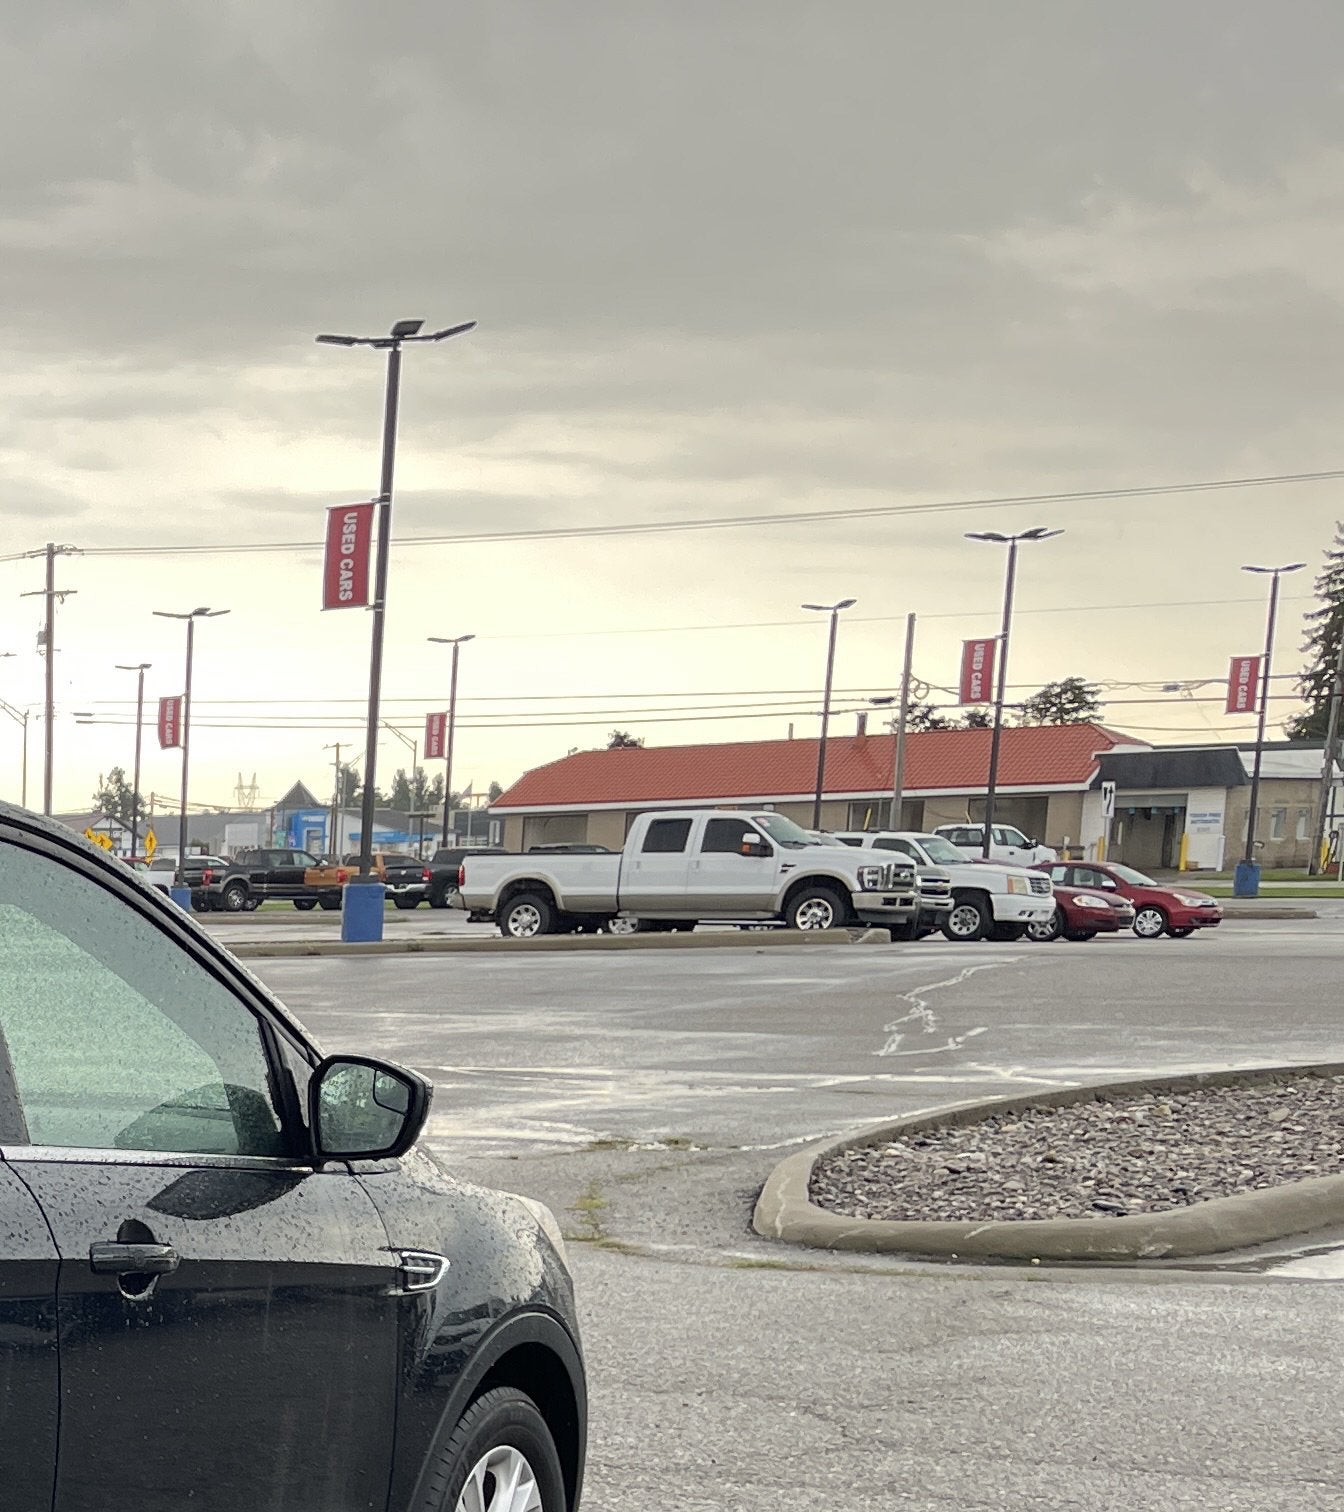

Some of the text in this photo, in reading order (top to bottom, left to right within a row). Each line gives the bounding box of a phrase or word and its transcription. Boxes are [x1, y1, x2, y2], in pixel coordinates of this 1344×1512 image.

[338, 512, 358, 601] USED CARS
[970, 643, 986, 699] USED CARS
